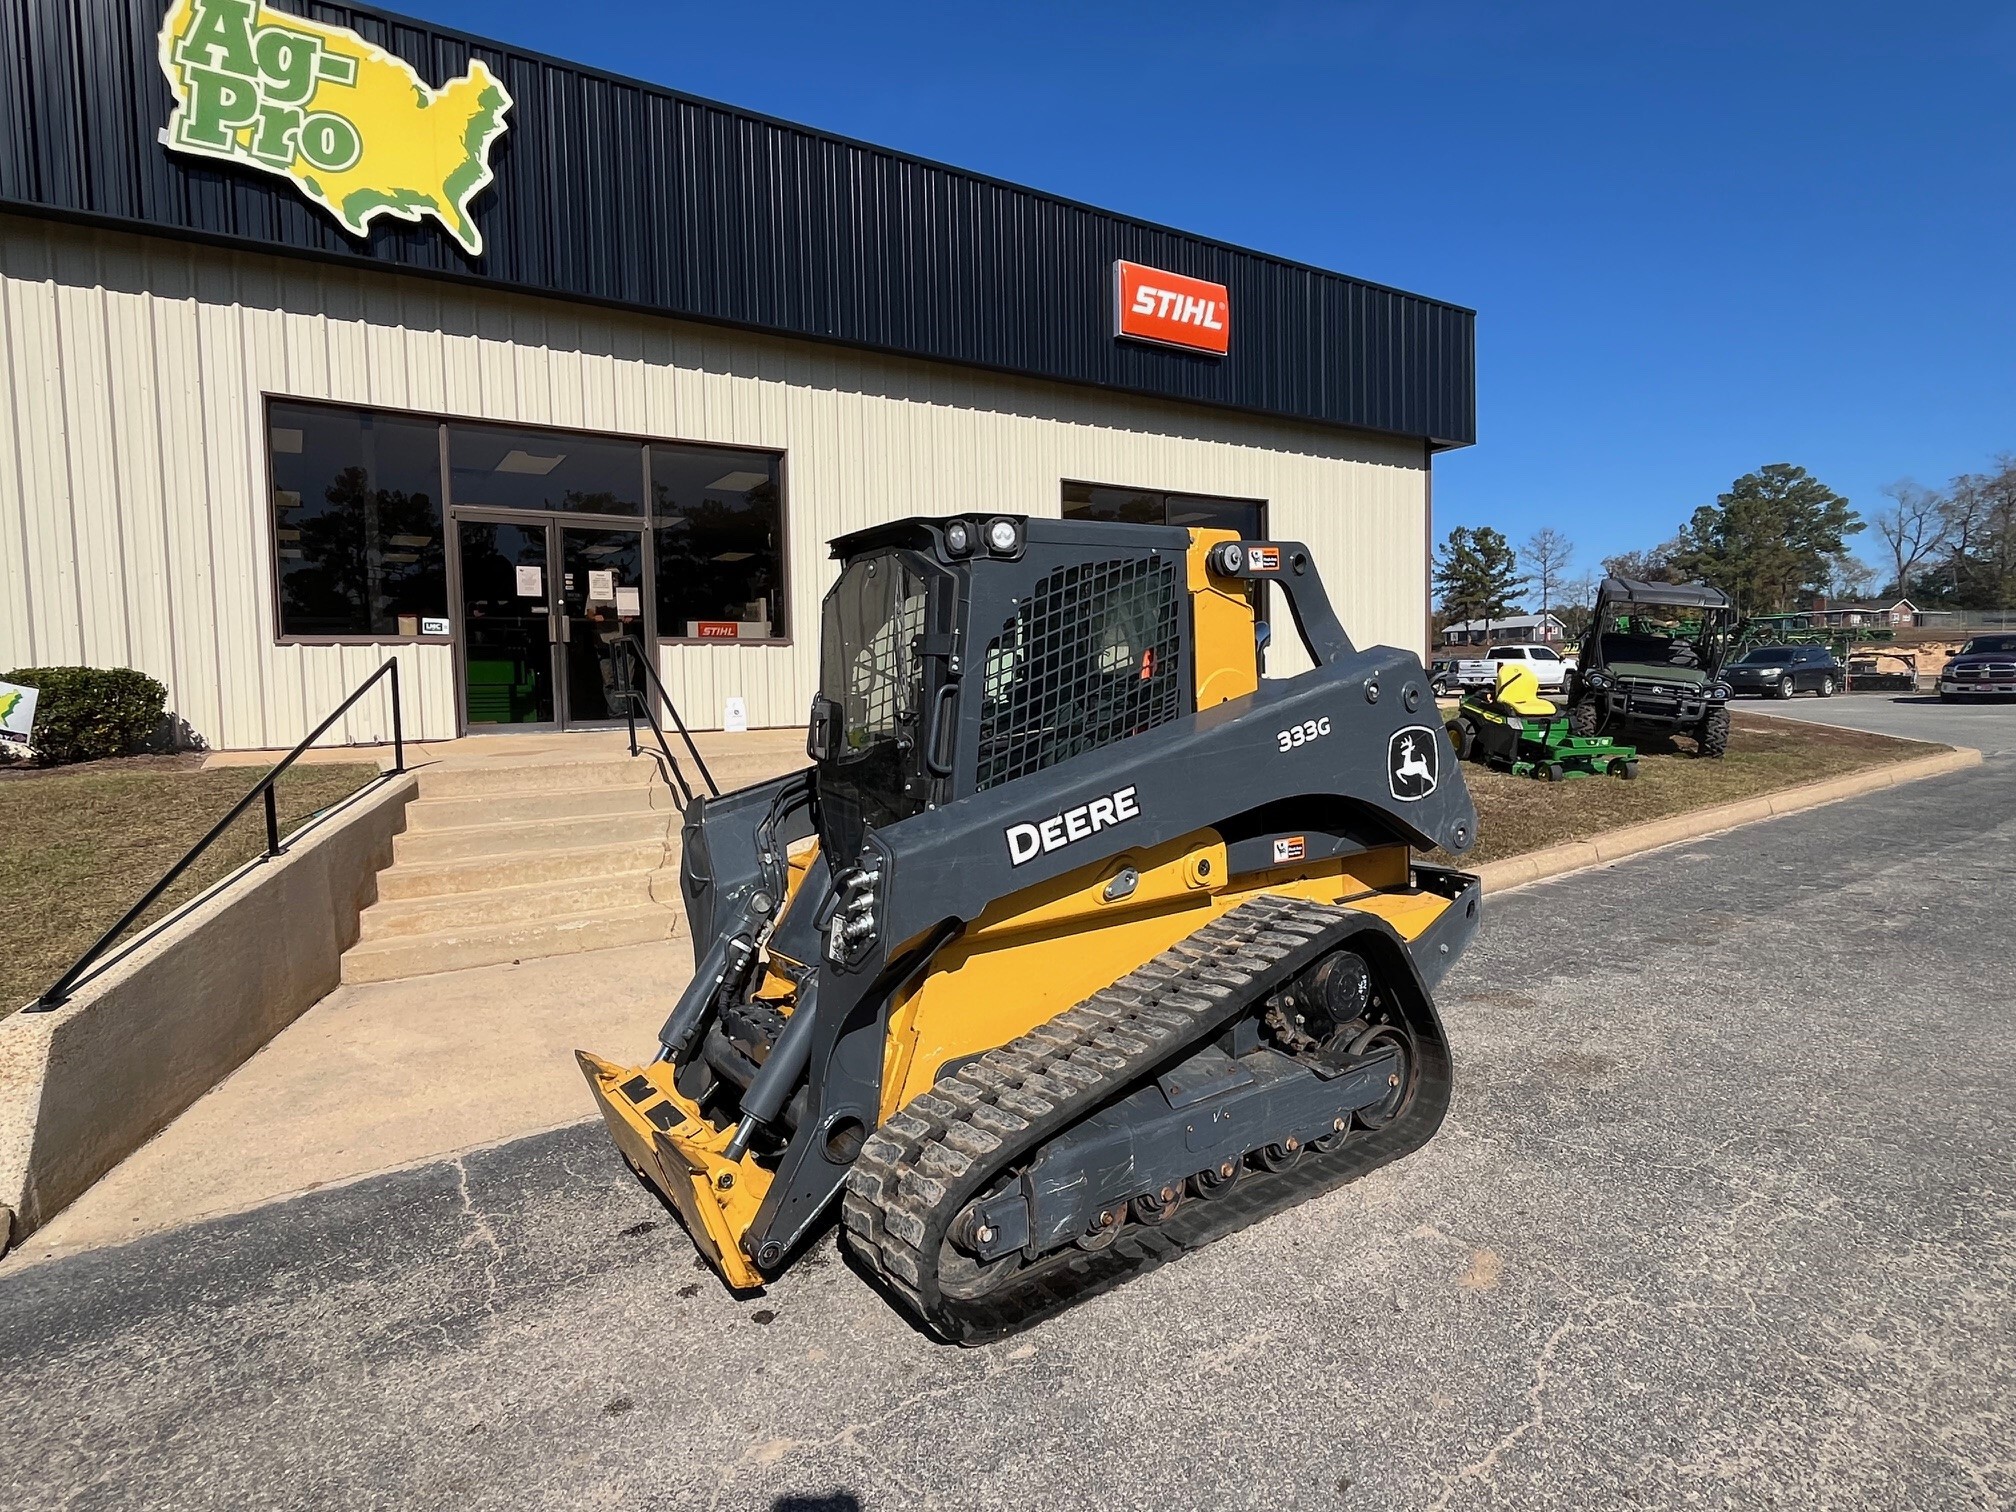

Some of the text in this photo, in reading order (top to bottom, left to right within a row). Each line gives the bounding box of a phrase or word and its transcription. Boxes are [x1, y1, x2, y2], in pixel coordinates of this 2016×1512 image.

[177, 0, 356, 104] Ag-
[180, 66, 361, 171] Pro
[1131, 285, 1223, 331] STIHL
[702, 627, 735, 636] STIHL
[1276, 716, 1331, 753] 333G
[1006, 786, 1140, 866] DEERE
